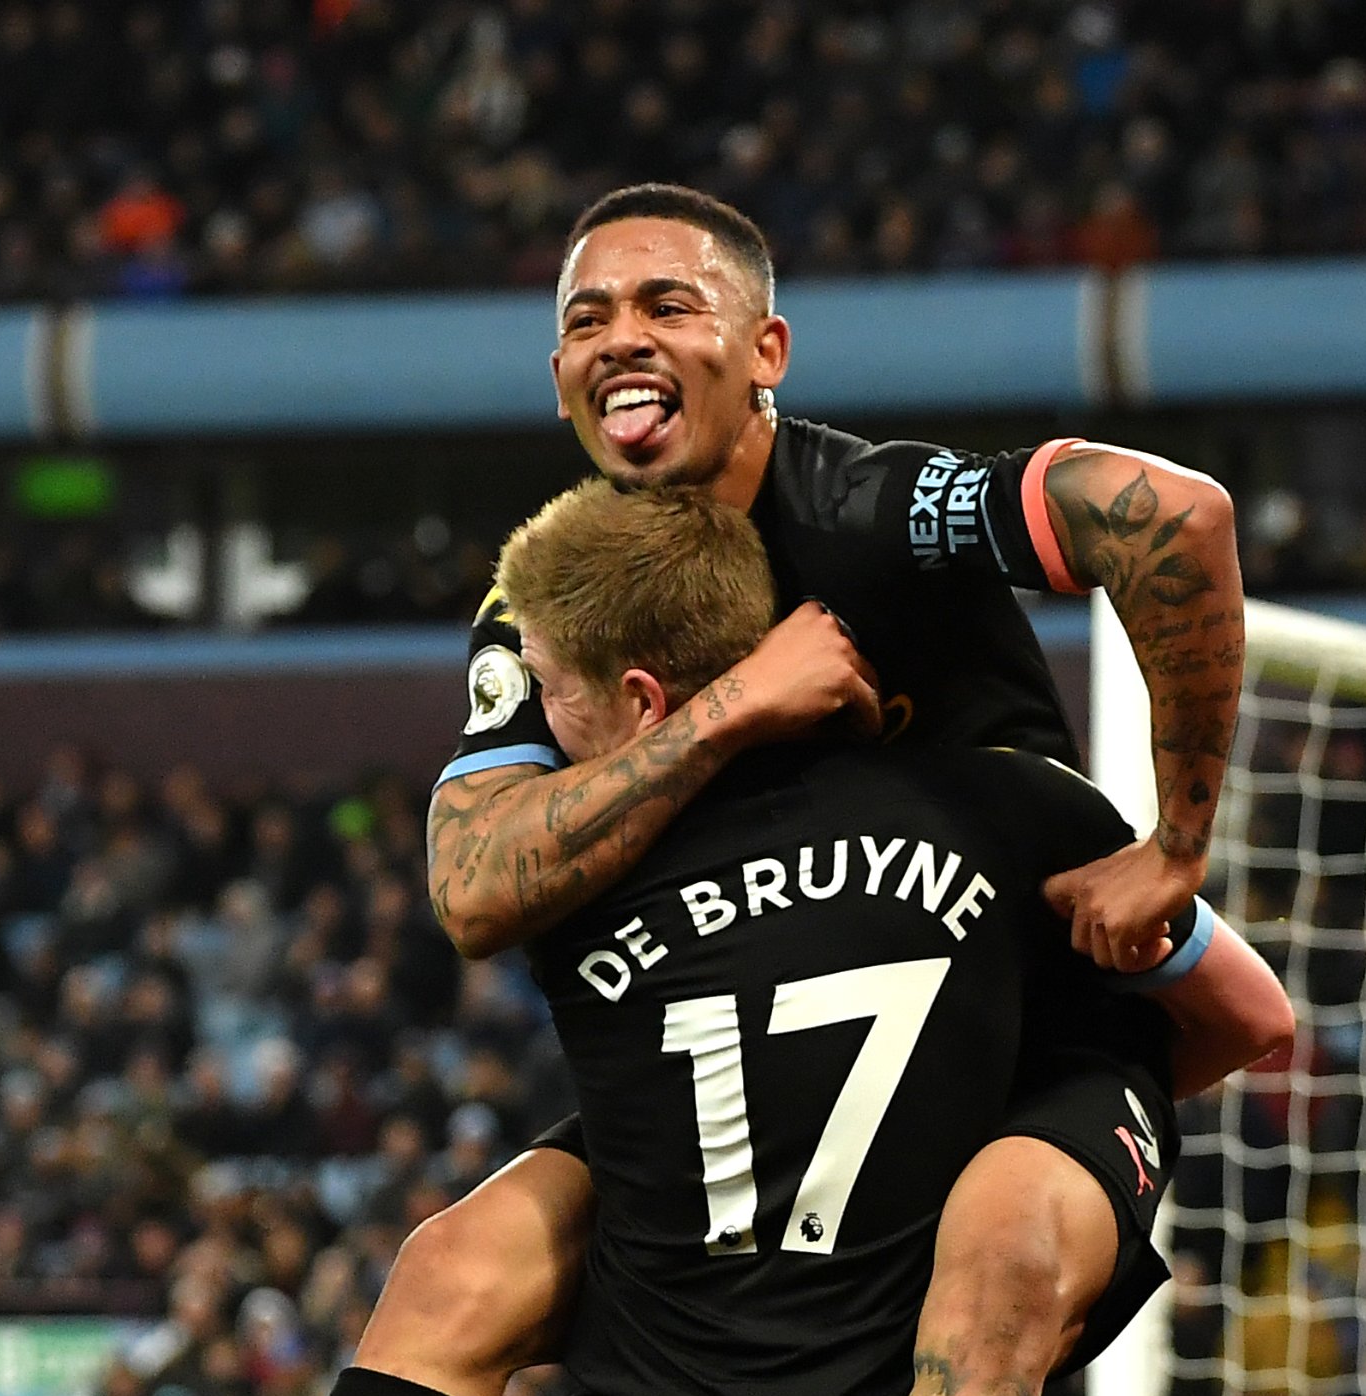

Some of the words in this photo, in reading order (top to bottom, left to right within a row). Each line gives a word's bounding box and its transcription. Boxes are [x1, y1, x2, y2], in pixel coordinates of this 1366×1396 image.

[577, 916, 669, 1002] DE
[679, 835, 996, 941] BRUYNE
[660, 957, 951, 1256] 17
